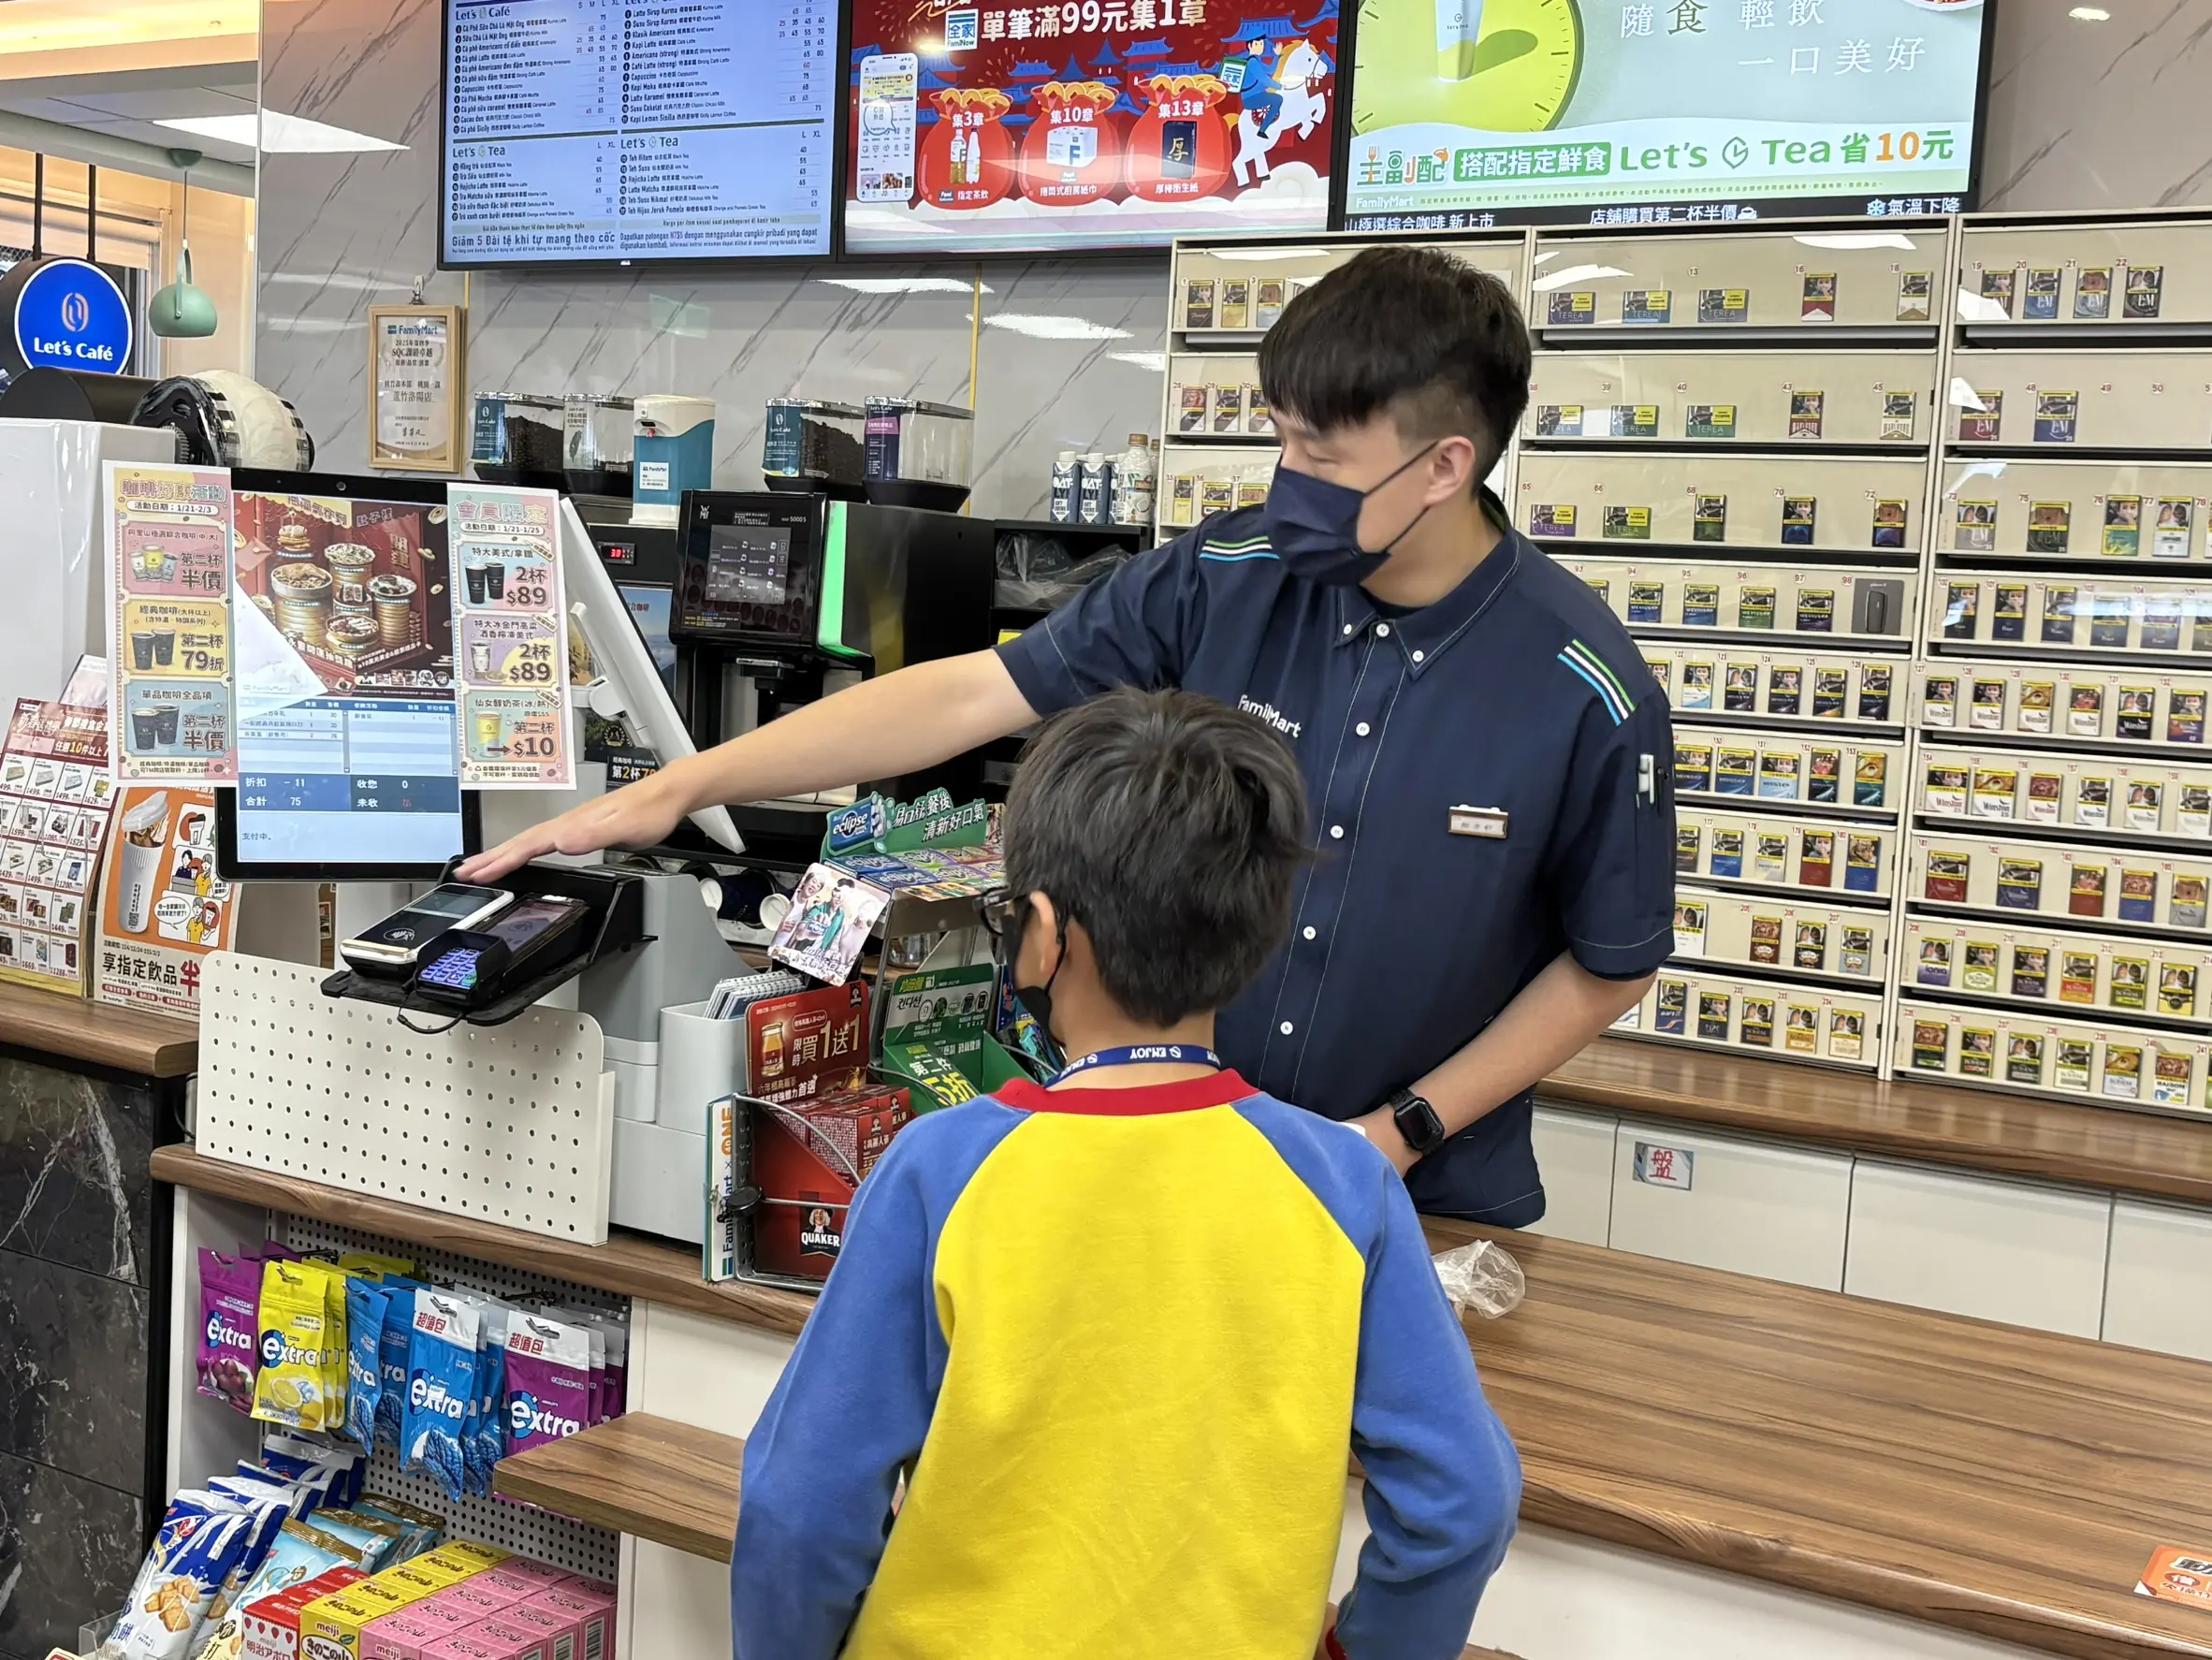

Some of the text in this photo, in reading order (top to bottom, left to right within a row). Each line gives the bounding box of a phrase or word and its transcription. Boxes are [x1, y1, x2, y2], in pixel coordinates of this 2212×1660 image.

[456, 7, 510, 21] Let's Café
[981, 0, 1207, 43] 單筆滿99元集1章
[948, 22, 976, 39] 全家
[1738, 36, 1926, 75] 一口美好
[1050, 106, 1094, 124] 集10章
[1157, 100, 1204, 119] 集13章
[953, 110, 984, 127] 集3章
[621, 137, 678, 149] Let's Tea
[1167, 137, 1189, 162] 厚
[453, 146, 505, 157] Let's Tea
[1460, 130, 1954, 178] 搭配指定鮮食 Let's Tea 省10元
[1357, 195, 1414, 209] FamilyMart
[1449, 213, 1495, 228] 新上市
[1887, 197, 1960, 216] 氣溫下降
[477, 236, 483, 246] 5
[515, 234, 530, 245] khi
[546, 235, 571, 247] mang
[575, 232, 595, 243] theo
[1795, 265, 1804, 273] 16
[1889, 263, 1899, 272] 18
[2016, 261, 2027, 269] 20
[2066, 260, 2076, 269] 21
[1558, 311, 1583, 320] TEREA
[1633, 310, 1660, 319] TEREA
[1708, 309, 1736, 318] TEREA
[399, 325, 438, 336] FamilyMart
[34, 337, 113, 361] Let's Café
[1873, 383, 1883, 391] 45
[2152, 384, 2163, 392] 50
[1622, 424, 1647, 434] TEREA
[1697, 425, 1723, 434] TEREA
[1774, 488, 1784, 497] 70
[2144, 497, 2154, 505] 77
[181, 552, 223, 567] 第二杯
[181, 569, 223, 591] 半價
[516, 566, 547, 585] 2杯
[1795, 575, 1804, 583] 97
[506, 586, 547, 607] $89
[181, 633, 224, 648] 第二杯
[519, 643, 551, 661] 2杯
[181, 650, 225, 671] 79折
[509, 662, 552, 683] $89
[183, 714, 226, 729] 第二杯
[1237, 694, 1302, 738] FamilyMart
[183, 731, 226, 752] 半價
[514, 736, 555, 758] $10
[245, 778, 267, 787] 折扣
[357, 779, 378, 789] 收您
[245, 796, 301, 807] 合計 75
[357, 798, 378, 808] 未收
[832, 812, 868, 835] eclipse
[921, 802, 985, 842] 清新好口氣
[800, 1013, 860, 1065] 買1送1
[792, 1038, 803, 1067] 限時
[1129, 1047, 1167, 1059] ENJOY
[801, 1231, 840, 1247] QUAKER
[416, 1311, 446, 1334] 超值包
[207, 1316, 252, 1350] extra
[263, 1336, 318, 1366] extra
[509, 1332, 545, 1355] 超值包
[348, 1350, 376, 1387] extra
[380, 1360, 406, 1383] tra
[411, 1378, 464, 1420] extra
[510, 1400, 580, 1438] extra
[316, 1622, 341, 1637] meiji
[376, 1645, 400, 1660] meiji
